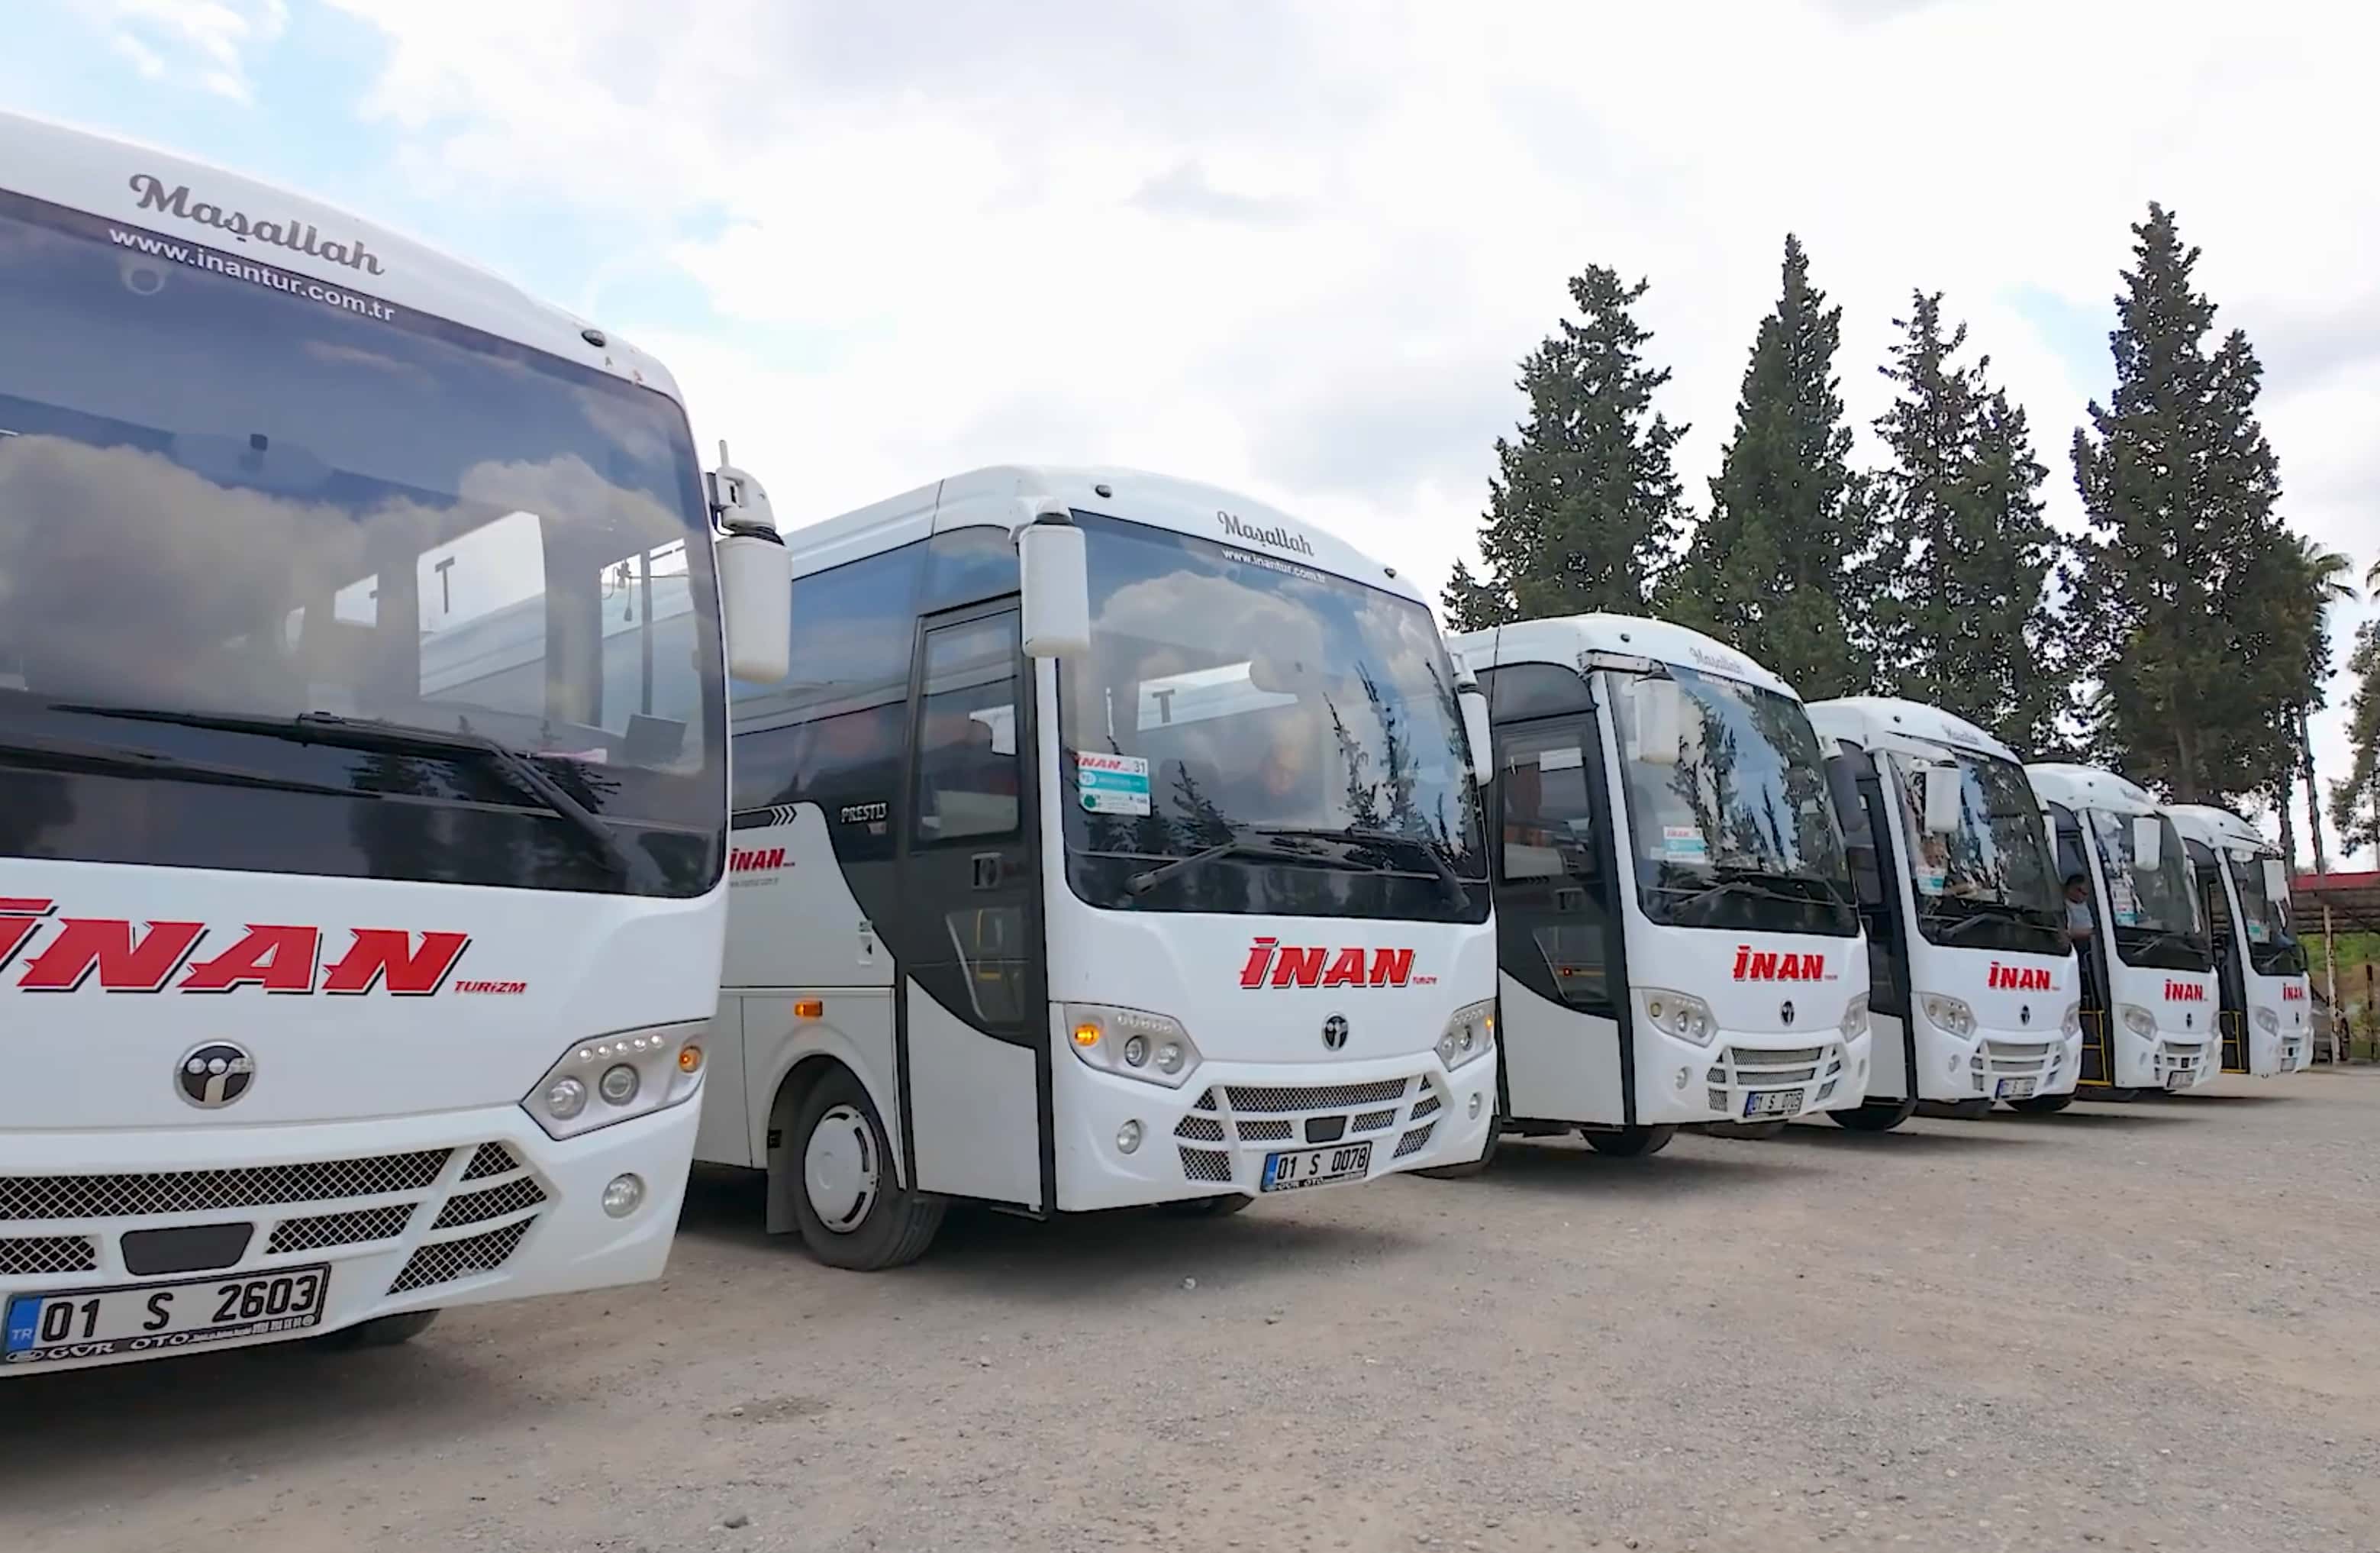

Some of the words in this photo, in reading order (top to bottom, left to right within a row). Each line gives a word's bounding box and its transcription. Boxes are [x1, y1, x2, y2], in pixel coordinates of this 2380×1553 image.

[129, 173, 385, 276] Maşallah
[108, 229, 396, 321] www.inantur.com.tr
[1217, 510, 1314, 557] Maşallah
[729, 848, 786, 872] İNAN
[1239, 937, 1415, 990] İNAN
[1733, 944, 1825, 982] İNAN
[1988, 961, 2051, 991] İNAN
[2165, 978, 2204, 1003] İNAN
[1276, 1155, 1298, 1180] 01
[1308, 1153, 1321, 1175] S
[1330, 1146, 1369, 1173] 0078
[41, 1298, 102, 1342] 01
[143, 1292, 175, 1331] S
[211, 1274, 319, 1323] 2603
[11, 1329, 33, 1341] TR
